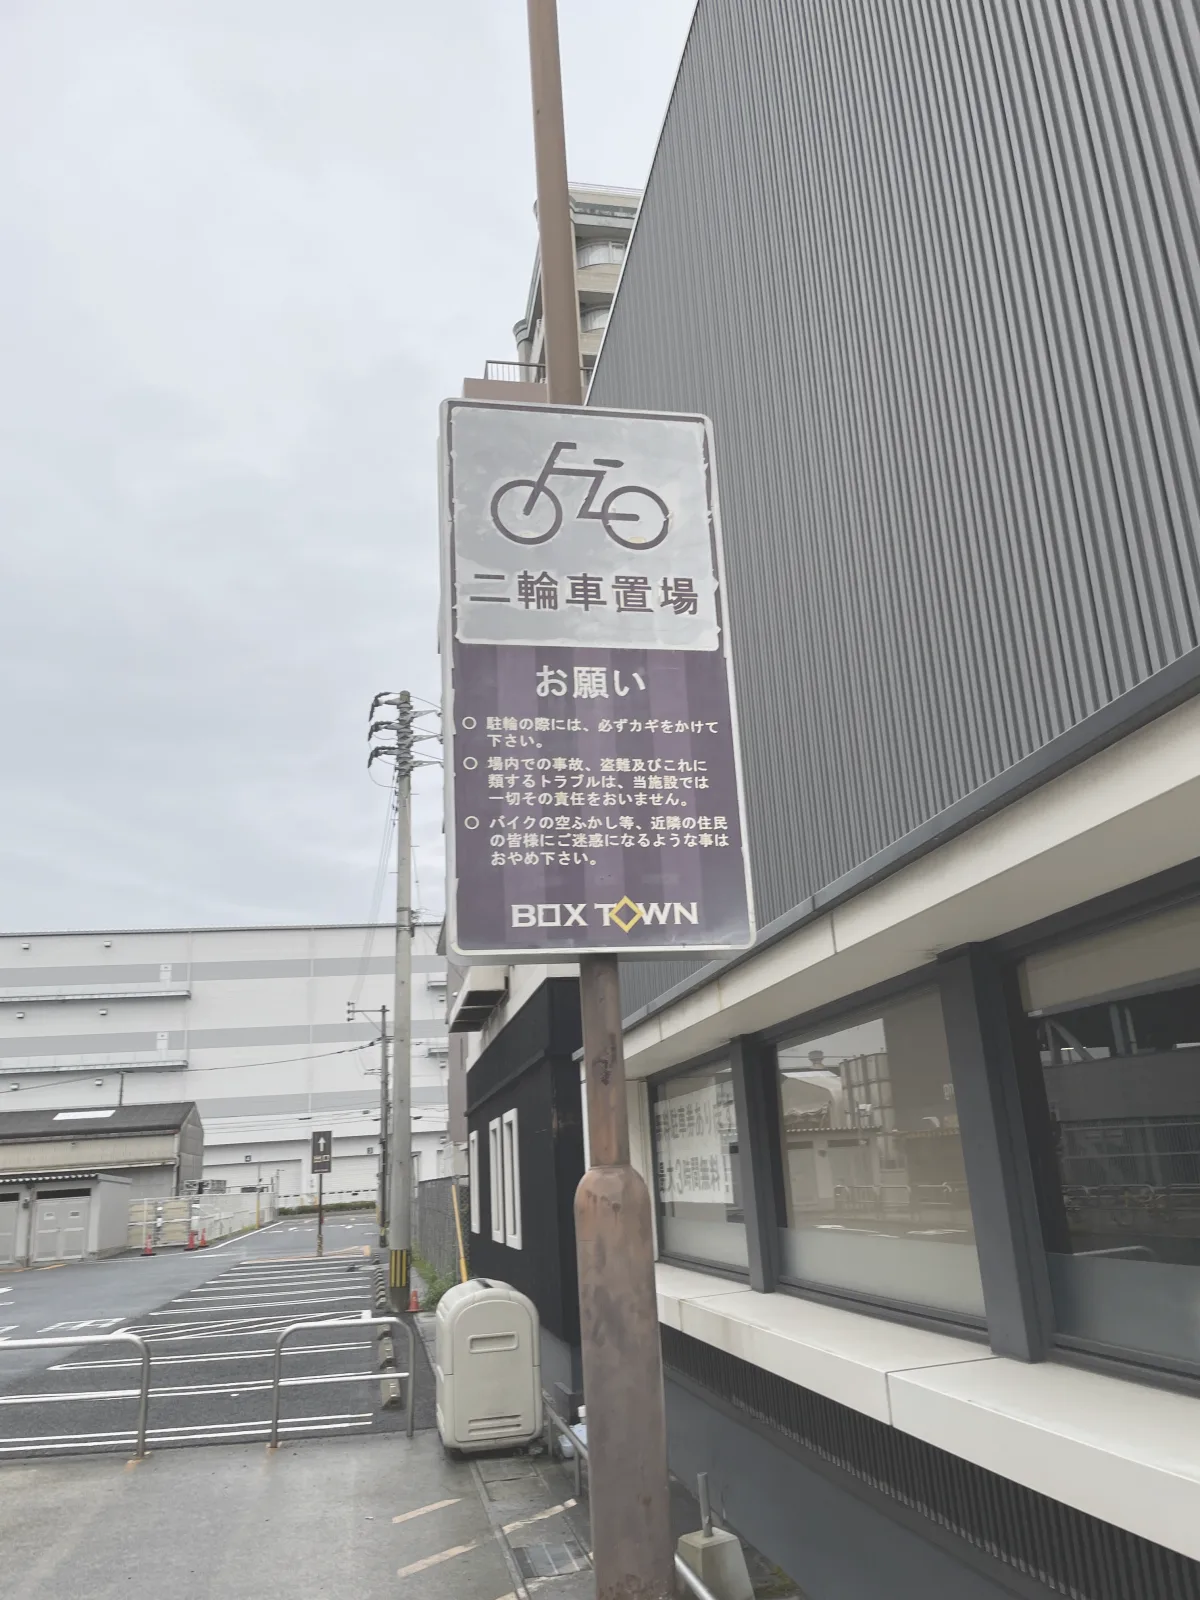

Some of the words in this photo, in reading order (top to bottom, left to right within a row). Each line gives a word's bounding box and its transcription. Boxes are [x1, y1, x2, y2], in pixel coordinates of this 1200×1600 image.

[470, 570, 698, 615] 二輪車置場
[536, 665, 646, 699] お願い
[486, 734, 543, 749] 下さい。
[488, 791, 688, 807] 一切その責任をおいません。
[489, 832, 730, 848] の皆様にご迷惑になるような事は
[490, 851, 597, 866] おやめ下さい。
[510, 902, 588, 928] BOX
[594, 895, 700, 933] TOWN
